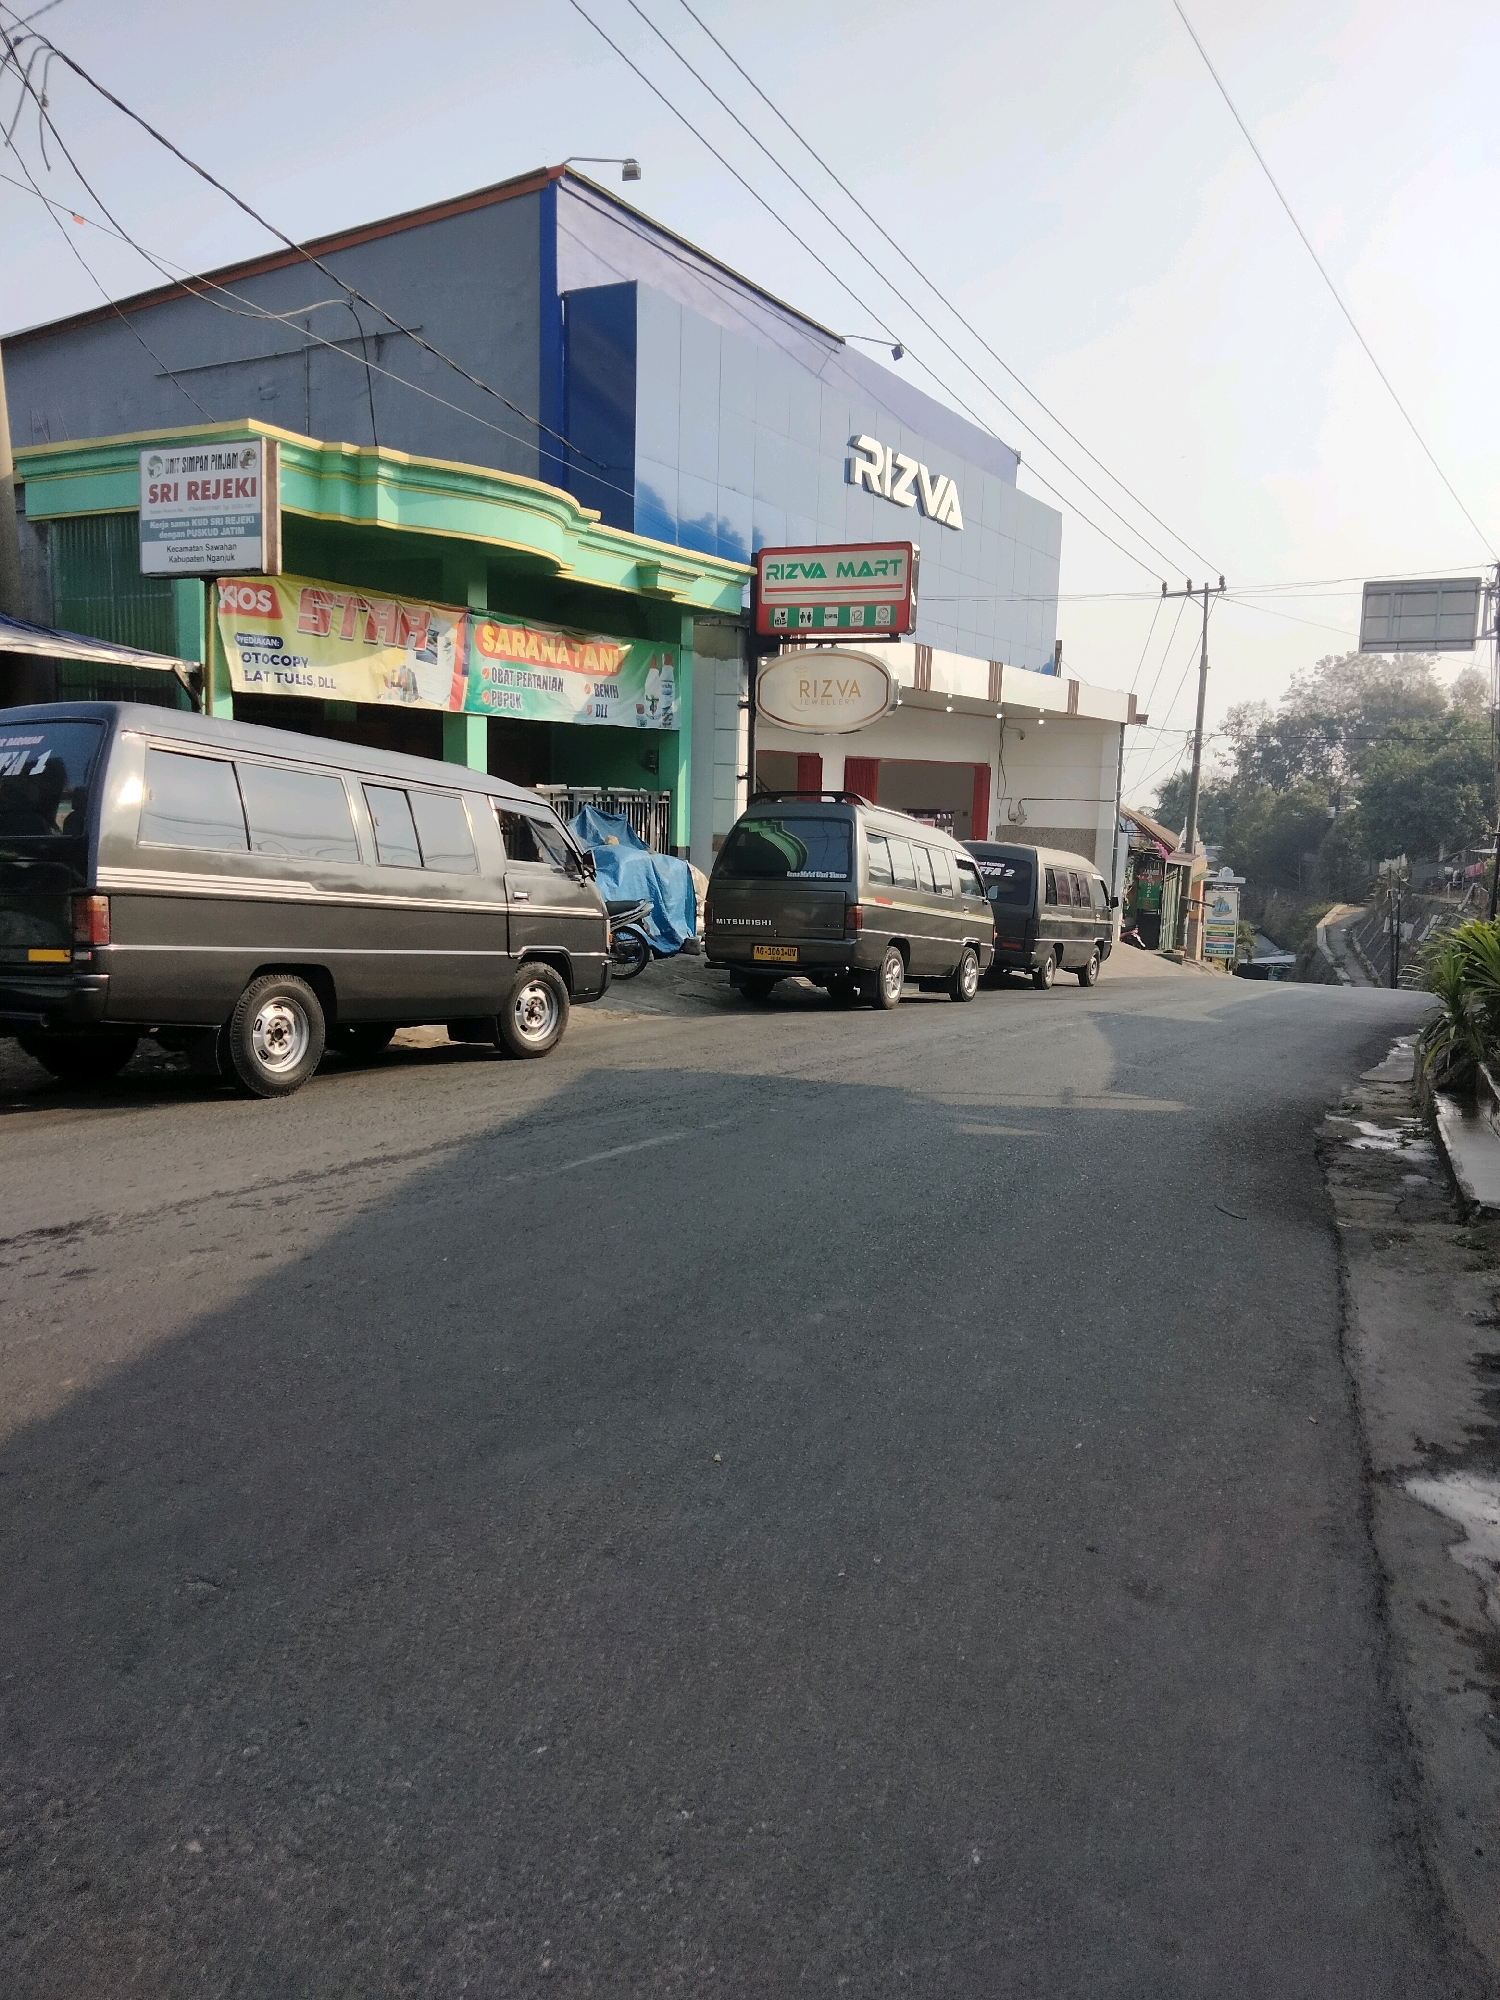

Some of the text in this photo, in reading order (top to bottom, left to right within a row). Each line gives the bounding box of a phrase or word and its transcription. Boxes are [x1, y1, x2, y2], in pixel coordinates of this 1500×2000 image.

[182, 454, 209, 473] SIMPAN
[211, 452, 238, 471] PINJAM
[148, 477, 257, 504] SRI REJEKI
[848, 434, 963, 531] RIZVA
[150, 521, 169, 530] Kerja
[211, 517, 223, 525] SRI
[225, 515, 255, 525] REJEKI
[159, 527, 245, 540] dengan PUSKUD JATIM
[166, 543, 237, 553] Kecamatan Sawahan
[168, 553, 235, 564] Kabupaten Nganjuk
[766, 558, 903, 580] RIZVA MART
[297, 588, 431, 651] STAR
[244, 669, 270, 683] LAT
[318, 676, 336, 689] DLL
[491, 667, 564, 692] OBAT PERTANIAN
[799, 679, 861, 698] RIZVA
[491, 690, 522, 709] PUPUK
[594, 683, 619, 699] BENIH
[595, 704, 608, 718] DLL
[1003, 868, 1015, 877] 2
[716, 918, 772, 926] MITSUBISHI
